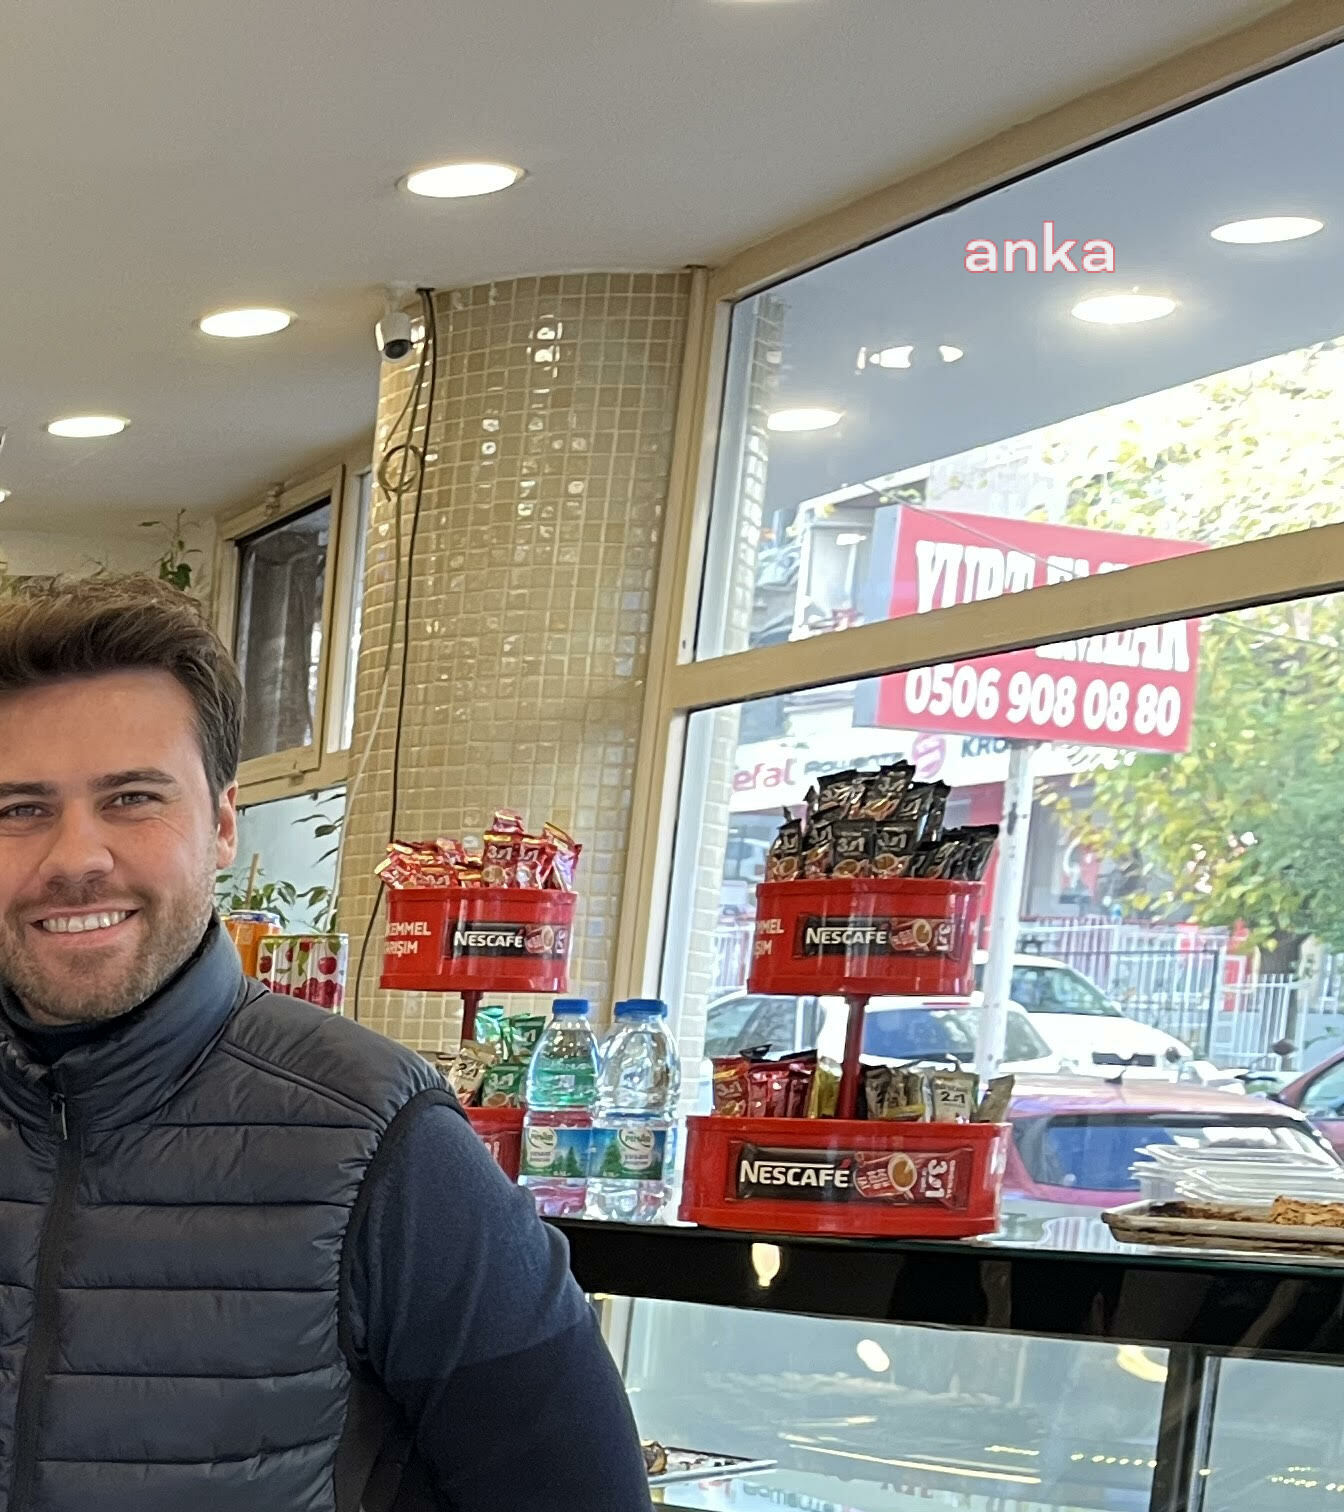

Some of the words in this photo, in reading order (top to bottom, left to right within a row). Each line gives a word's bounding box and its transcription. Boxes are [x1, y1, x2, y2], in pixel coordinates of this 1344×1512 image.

[905, 664, 1001, 720] 0506
[1006, 671, 1078, 728] 908
[1083, 679, 1130, 732] 08
[1134, 684, 1181, 737] 80
